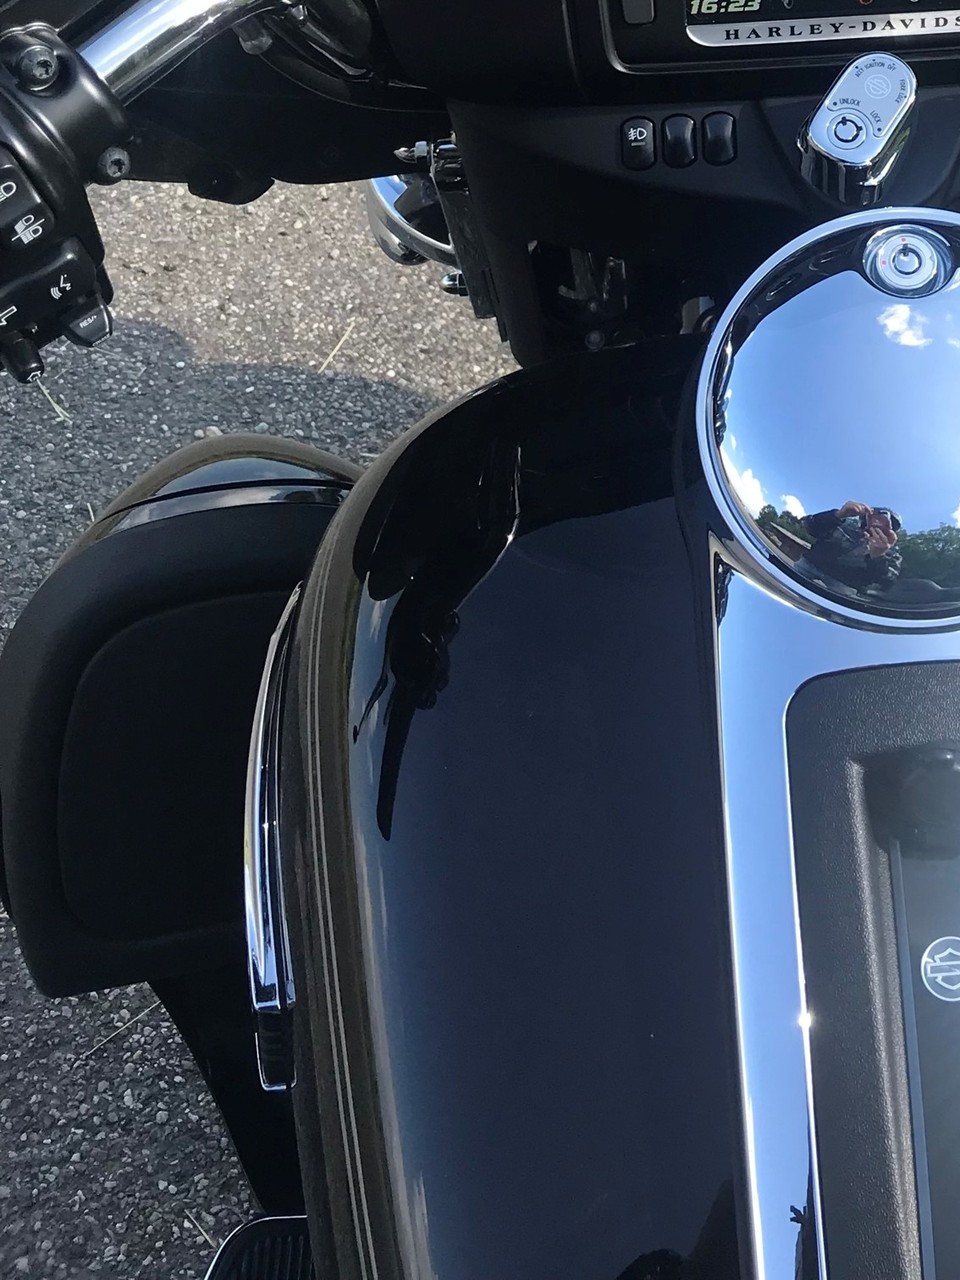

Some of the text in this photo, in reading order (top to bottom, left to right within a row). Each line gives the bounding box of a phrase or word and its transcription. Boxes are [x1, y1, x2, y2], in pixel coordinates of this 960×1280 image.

[864, 61, 885, 69] IGNITION
[839, 98, 861, 106] UNLOCK
[870, 110, 881, 123] LOCK
